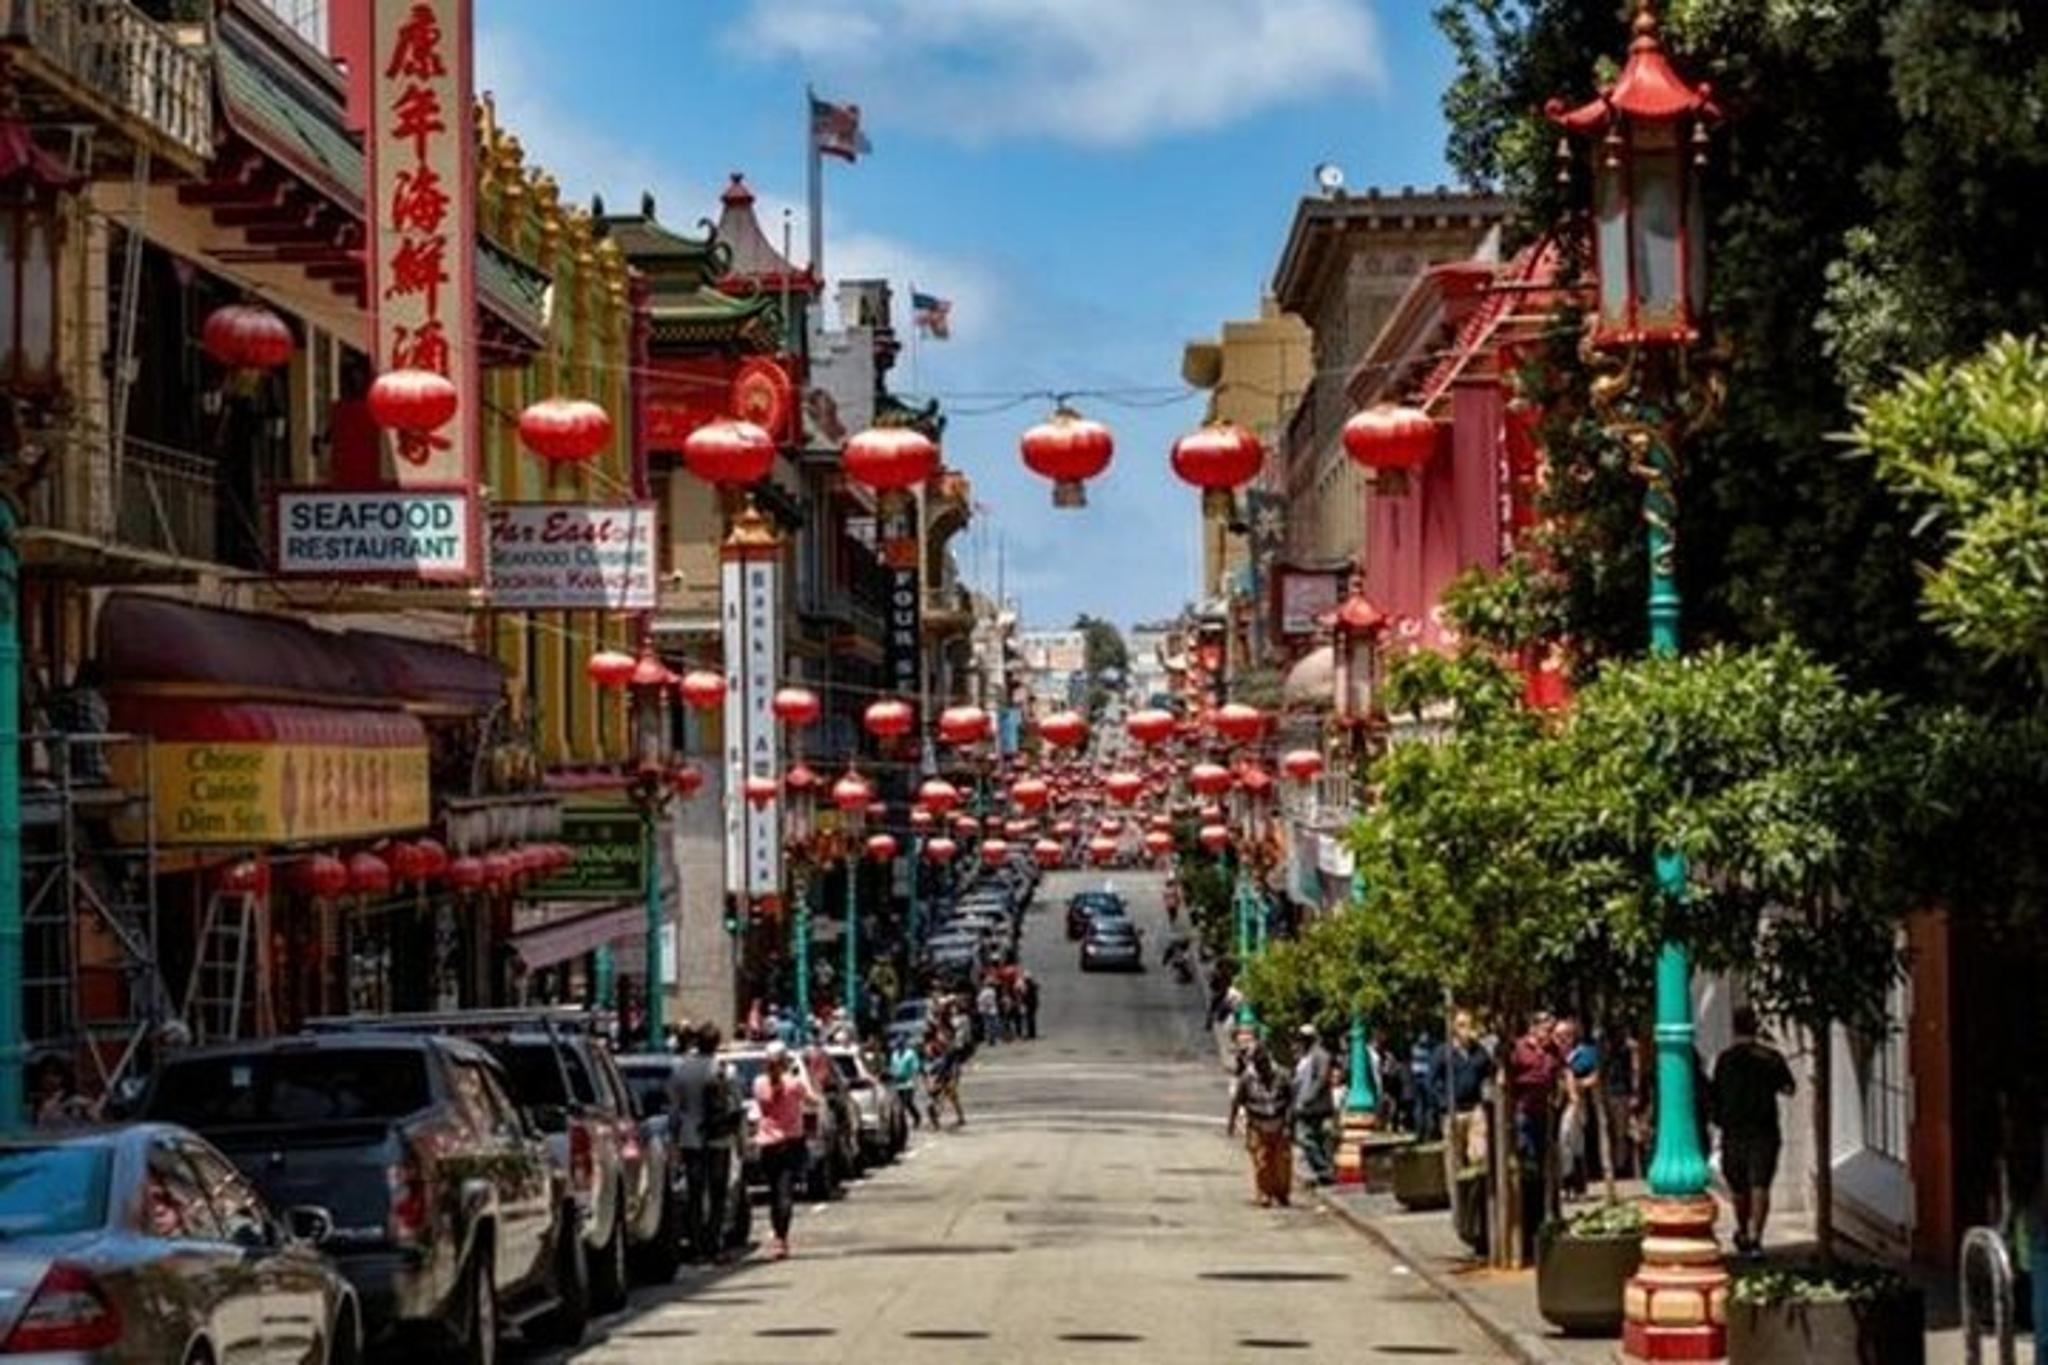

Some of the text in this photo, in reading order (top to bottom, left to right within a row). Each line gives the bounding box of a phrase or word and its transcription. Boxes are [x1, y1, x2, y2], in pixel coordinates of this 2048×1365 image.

[291, 502, 453, 531] SEAFOOD
[542, 511, 612, 543] East
[287, 535, 456, 560] RESTAURANT
